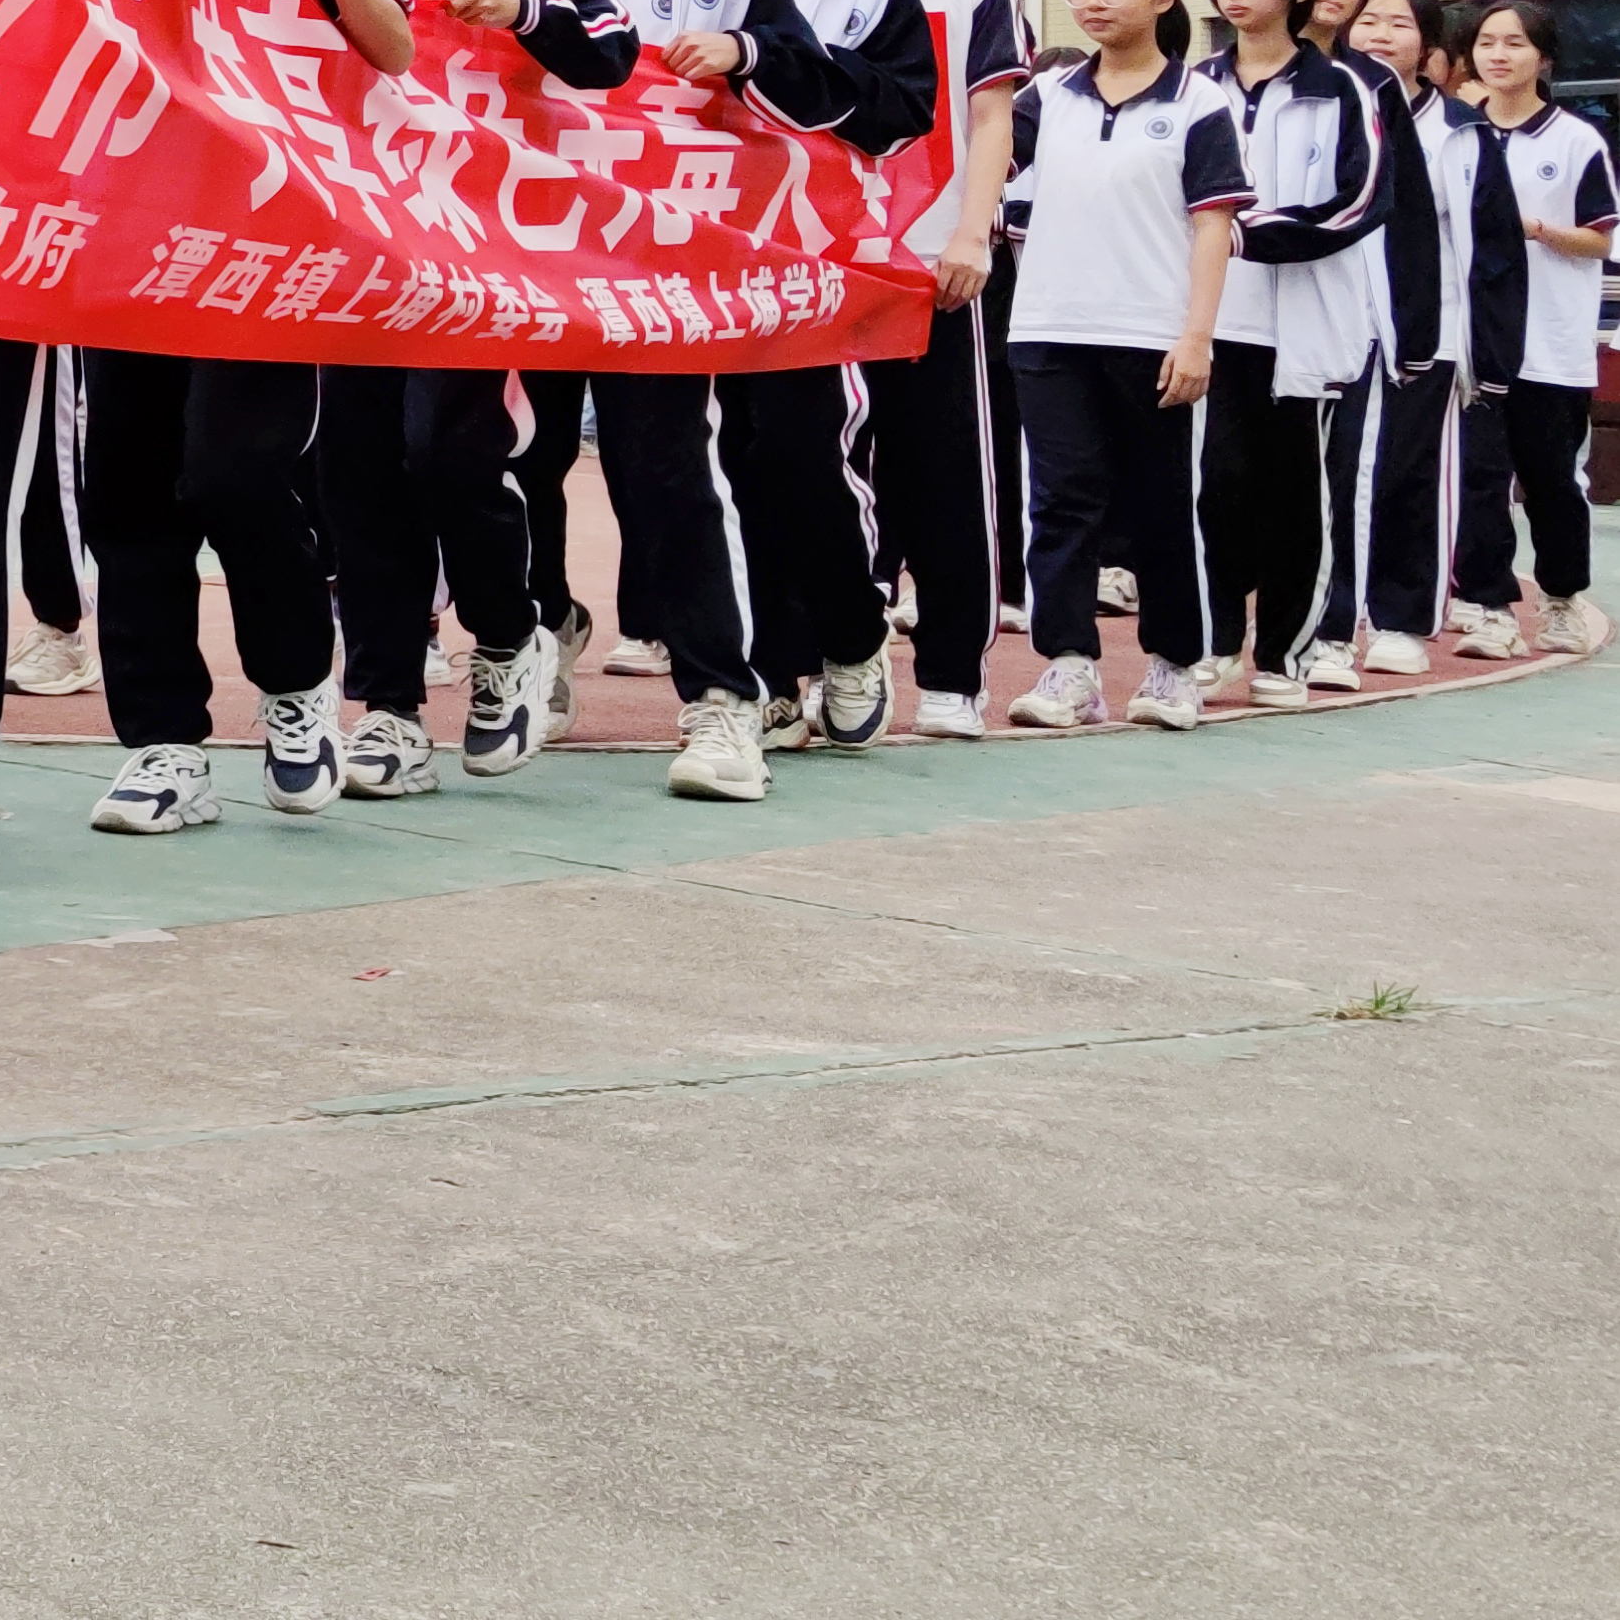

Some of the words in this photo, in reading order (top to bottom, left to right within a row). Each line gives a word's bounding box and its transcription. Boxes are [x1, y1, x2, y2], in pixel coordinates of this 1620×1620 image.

[128, 223, 570, 343] 潭西镇上埔村委会
[575, 260, 847, 348] 潭西镇上埔学校
